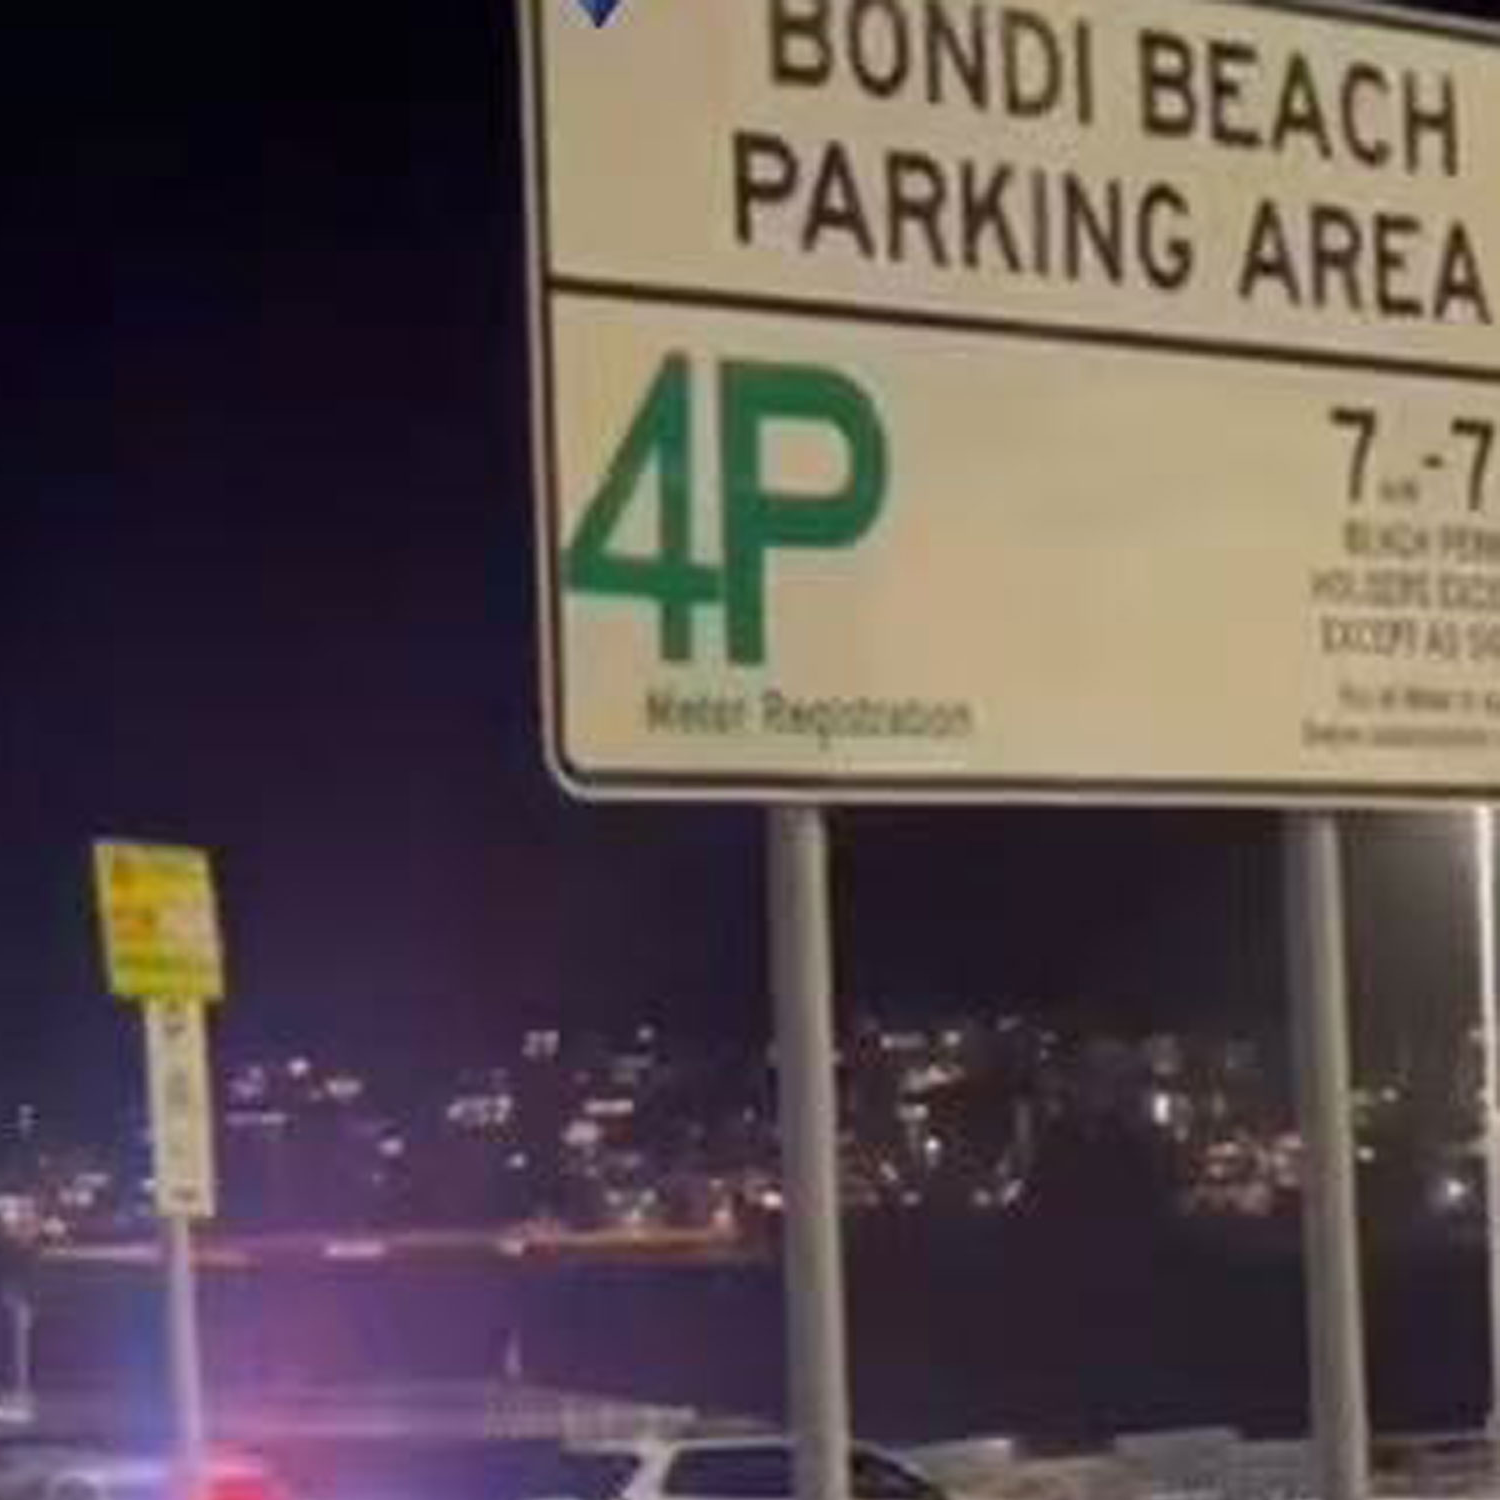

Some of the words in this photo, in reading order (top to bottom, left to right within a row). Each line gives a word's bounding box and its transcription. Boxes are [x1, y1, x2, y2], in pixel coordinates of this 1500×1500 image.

[768, 0, 1093, 125] BONDI
[1137, 28, 1458, 178] BEACH
[732, 129, 1194, 291] PARKING
[1238, 199, 1493, 326] AREA
[563, 352, 891, 668] 4P
[644, 691, 747, 735] Meter
[760, 688, 976, 752] Registration
